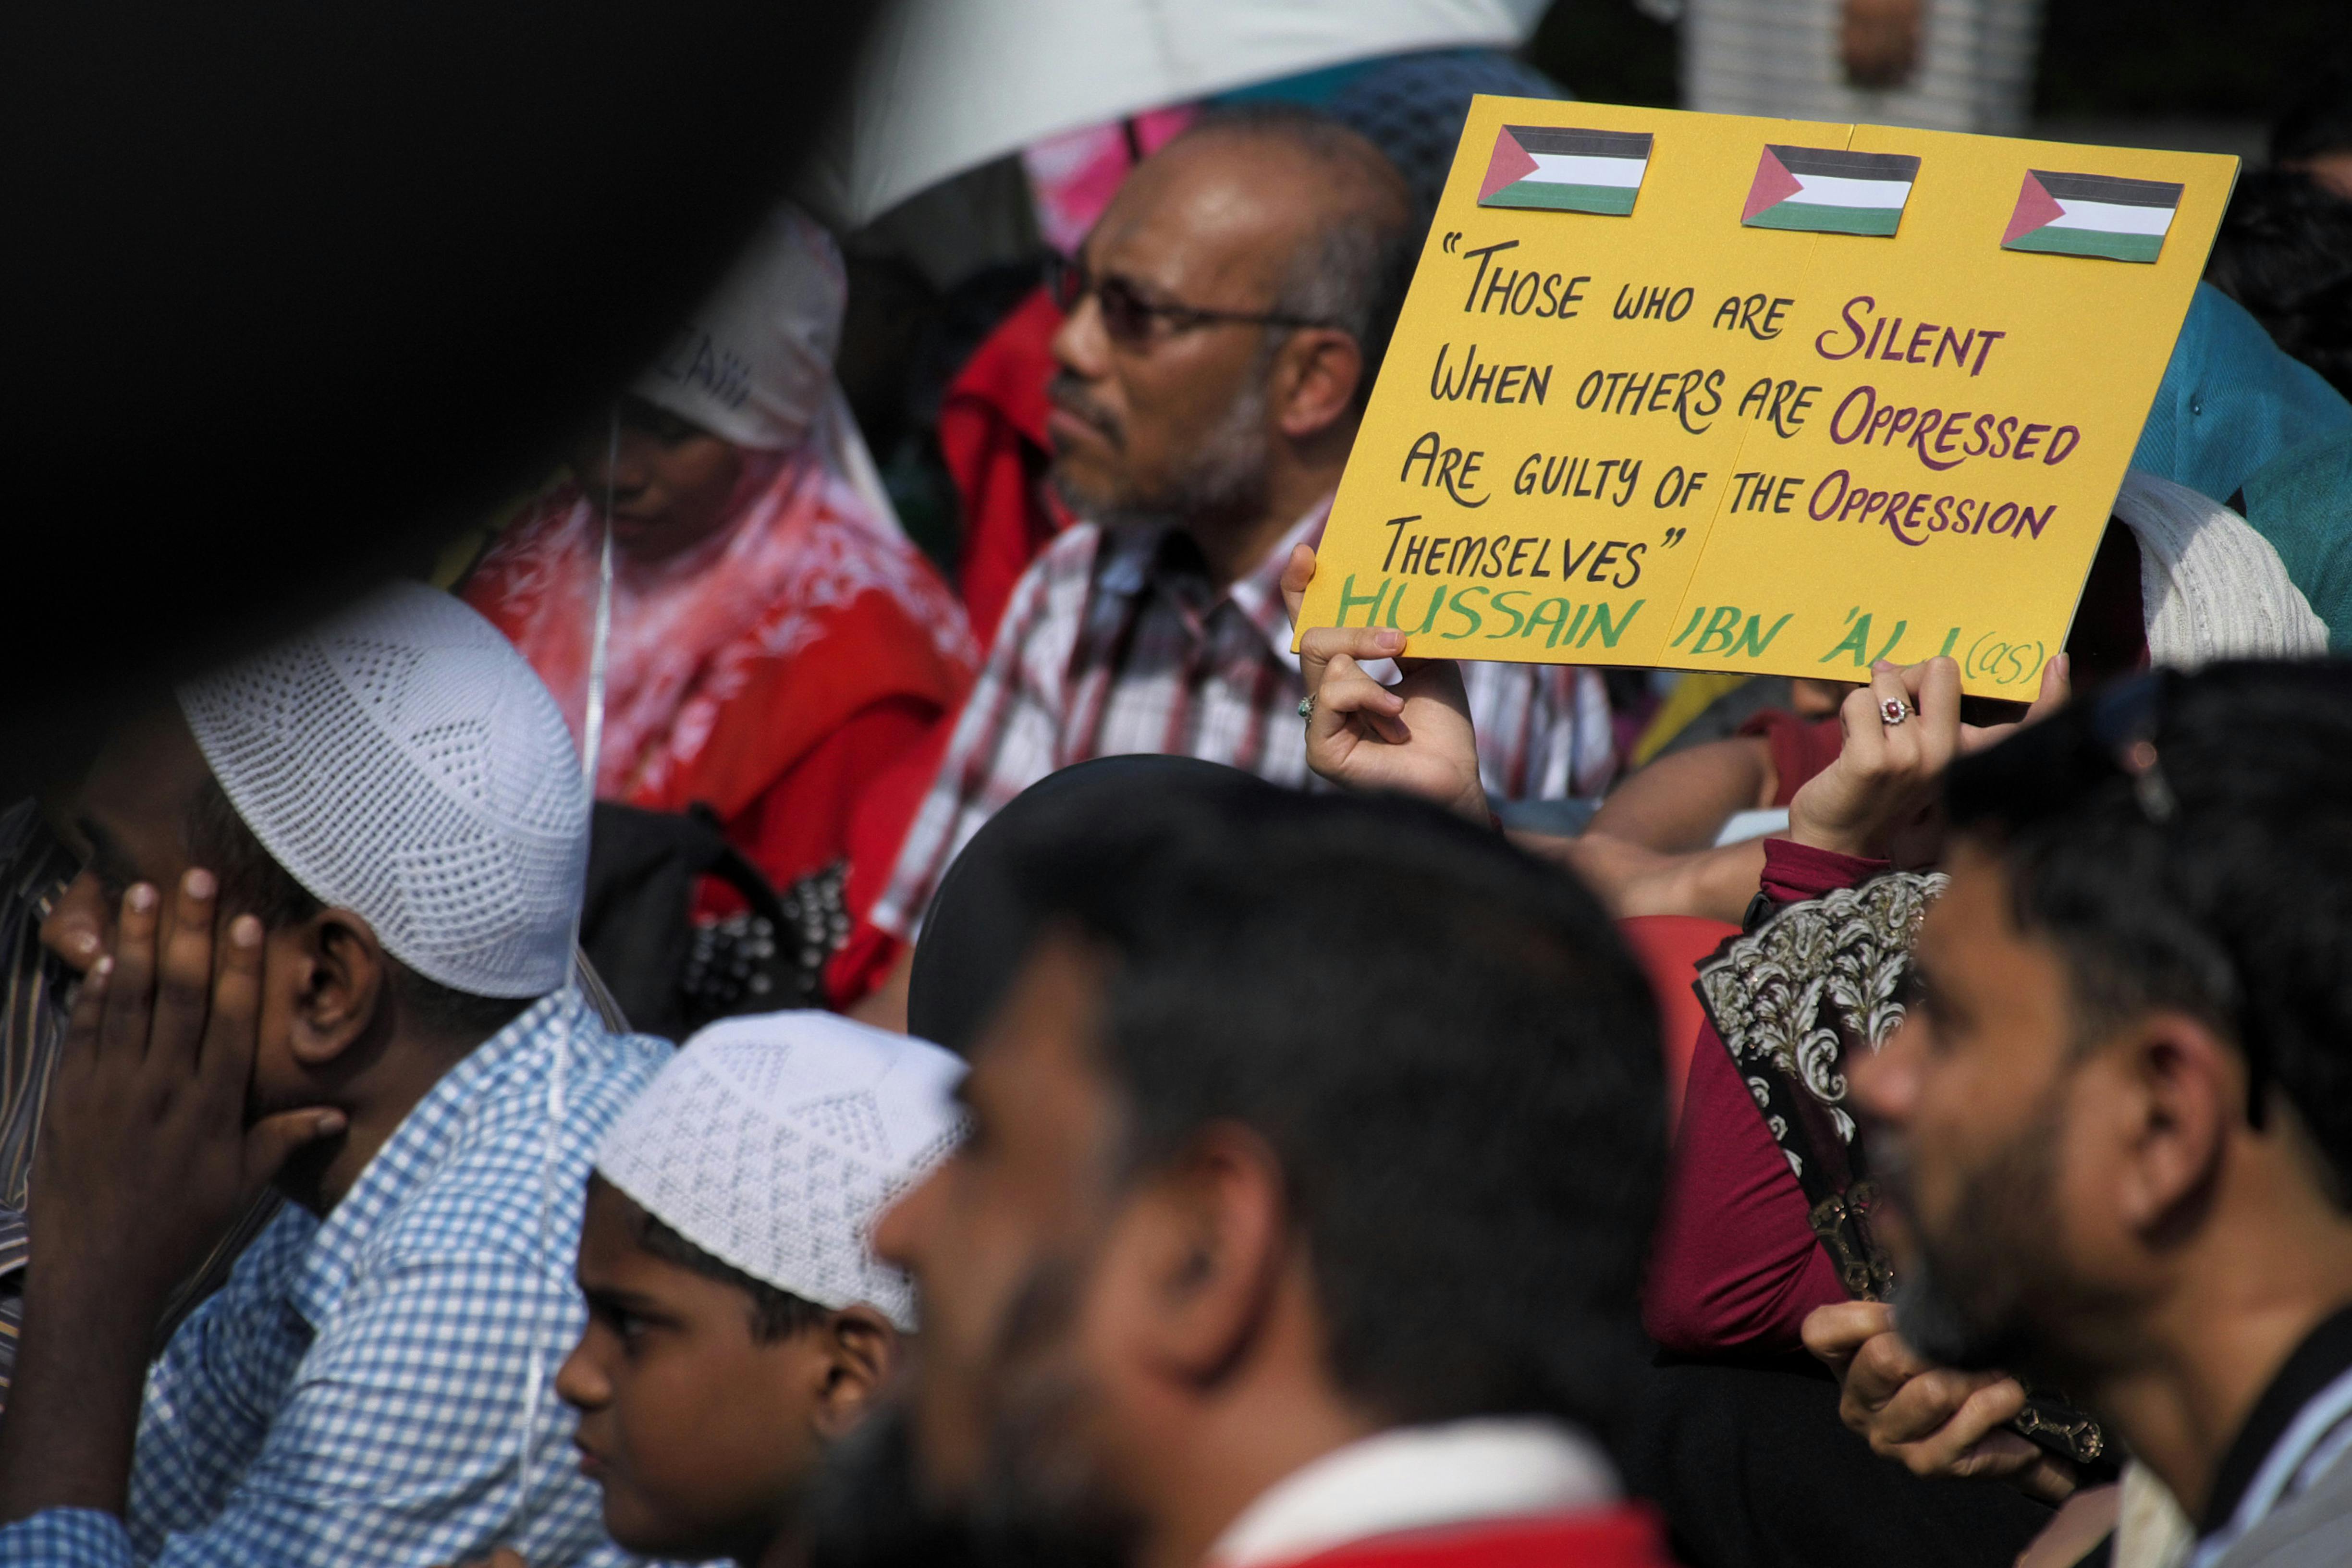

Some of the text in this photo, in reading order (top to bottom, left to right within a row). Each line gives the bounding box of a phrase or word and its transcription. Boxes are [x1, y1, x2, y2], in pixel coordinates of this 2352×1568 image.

[1442, 231, 2007, 378] “THOSE WHO ARE SILENT
[1430, 342, 2082, 472] WHEN OTHERS ARE OPPRESSED
[1400, 430, 2058, 547] ARE GUILTY OF THE OPPRESSION
[1335, 573, 1647, 649] HUSSAIN
[1670, 605, 1795, 658] IBN
